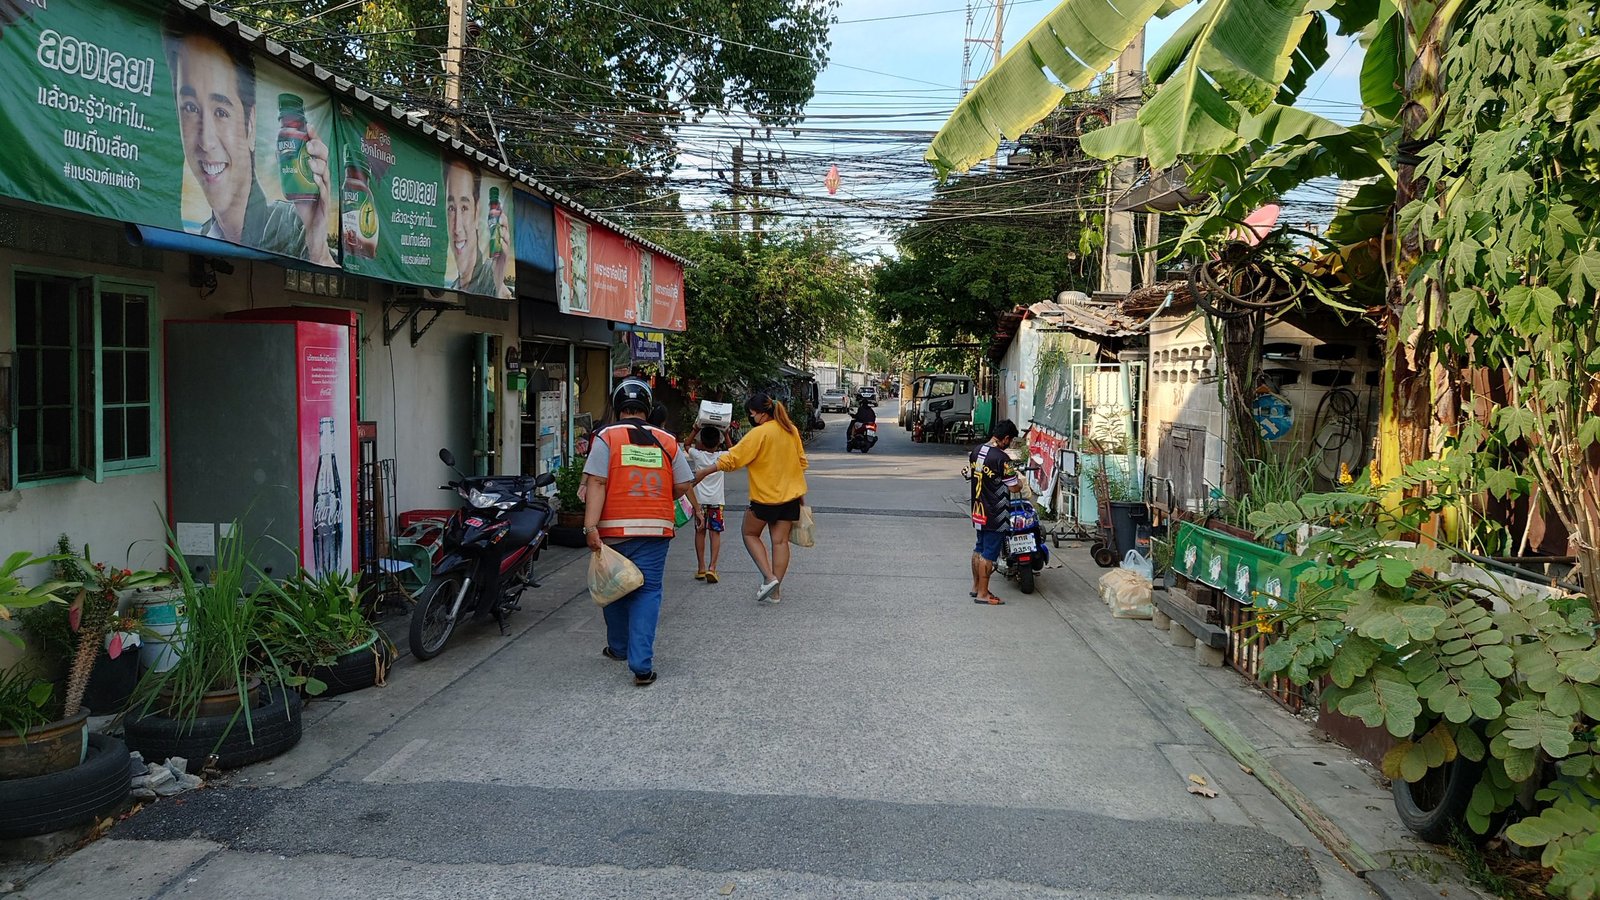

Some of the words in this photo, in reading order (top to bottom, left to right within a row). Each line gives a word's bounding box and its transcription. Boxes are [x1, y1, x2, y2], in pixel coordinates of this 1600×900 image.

[37, 29, 155, 96] ลองเลย!
[37, 84, 154, 132] แล้วจะรู้ว่าทำไม...
[63, 128, 139, 161] ผมถึงเลือก
[63, 162, 140, 190] #แบรนด์แต่เช้า
[391, 176, 437, 207] ลองเลย!
[628, 469, 662, 497] 29
